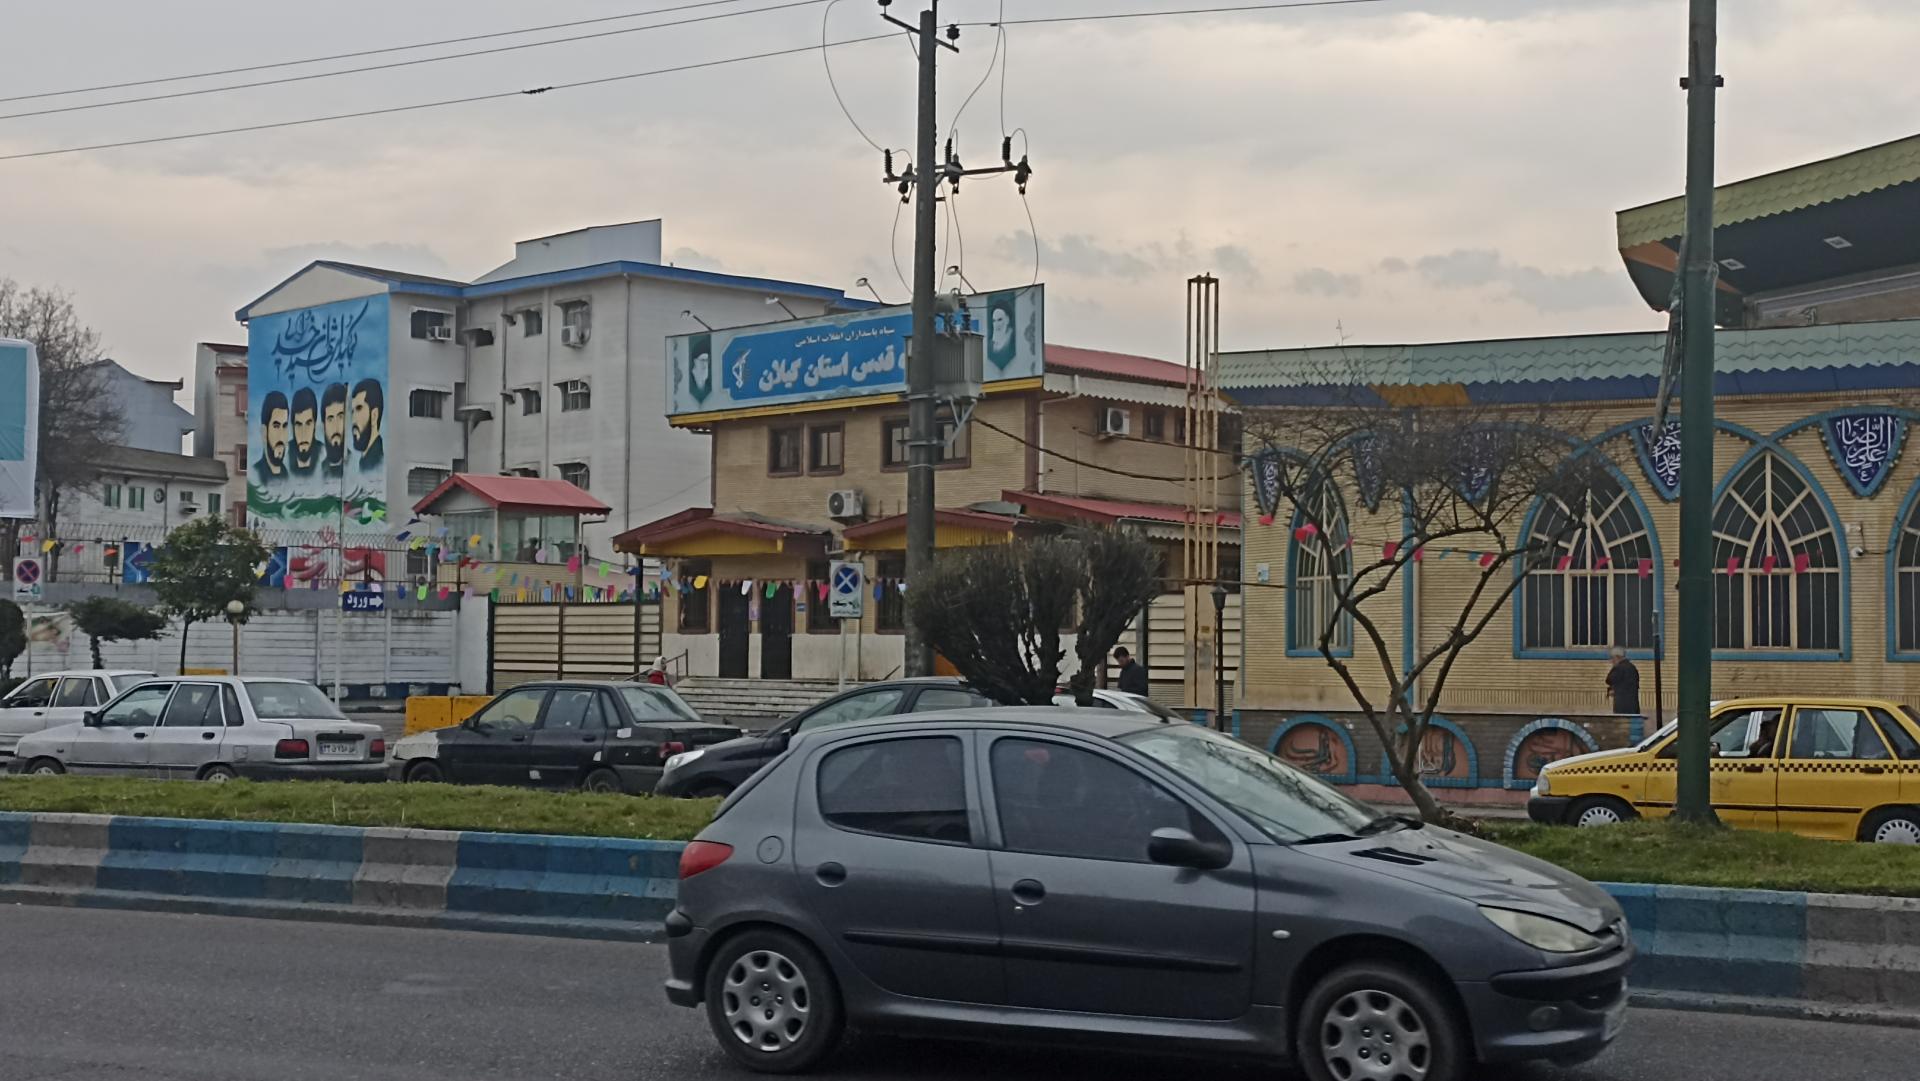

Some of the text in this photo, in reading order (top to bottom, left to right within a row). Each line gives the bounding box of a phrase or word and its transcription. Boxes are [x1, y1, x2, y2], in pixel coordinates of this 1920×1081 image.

[794, 325, 895, 348] سپاه پاسداران انقلاب اسلامی
[758, 358, 802, 392] گیلان
[803, 351, 849, 387] استان
[851, 344, 895, 382] قدس
[347, 594, 368, 609] ورود
